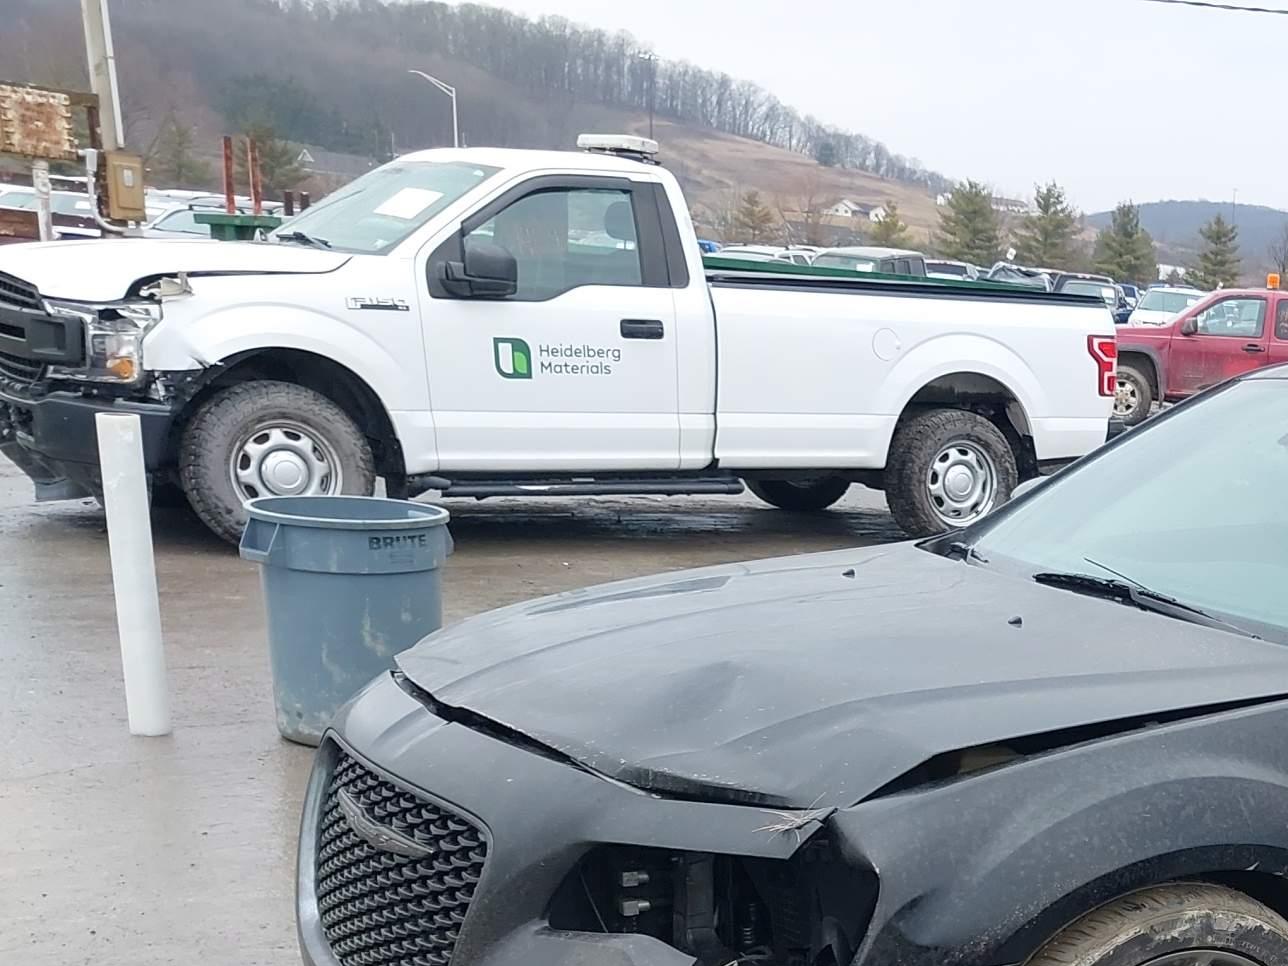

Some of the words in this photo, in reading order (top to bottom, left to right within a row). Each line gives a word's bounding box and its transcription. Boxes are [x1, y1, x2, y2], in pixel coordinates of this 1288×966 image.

[539, 344, 621, 362] Heidelberg
[540, 361, 612, 375] Materials
[368, 534, 426, 550] BRUTE
